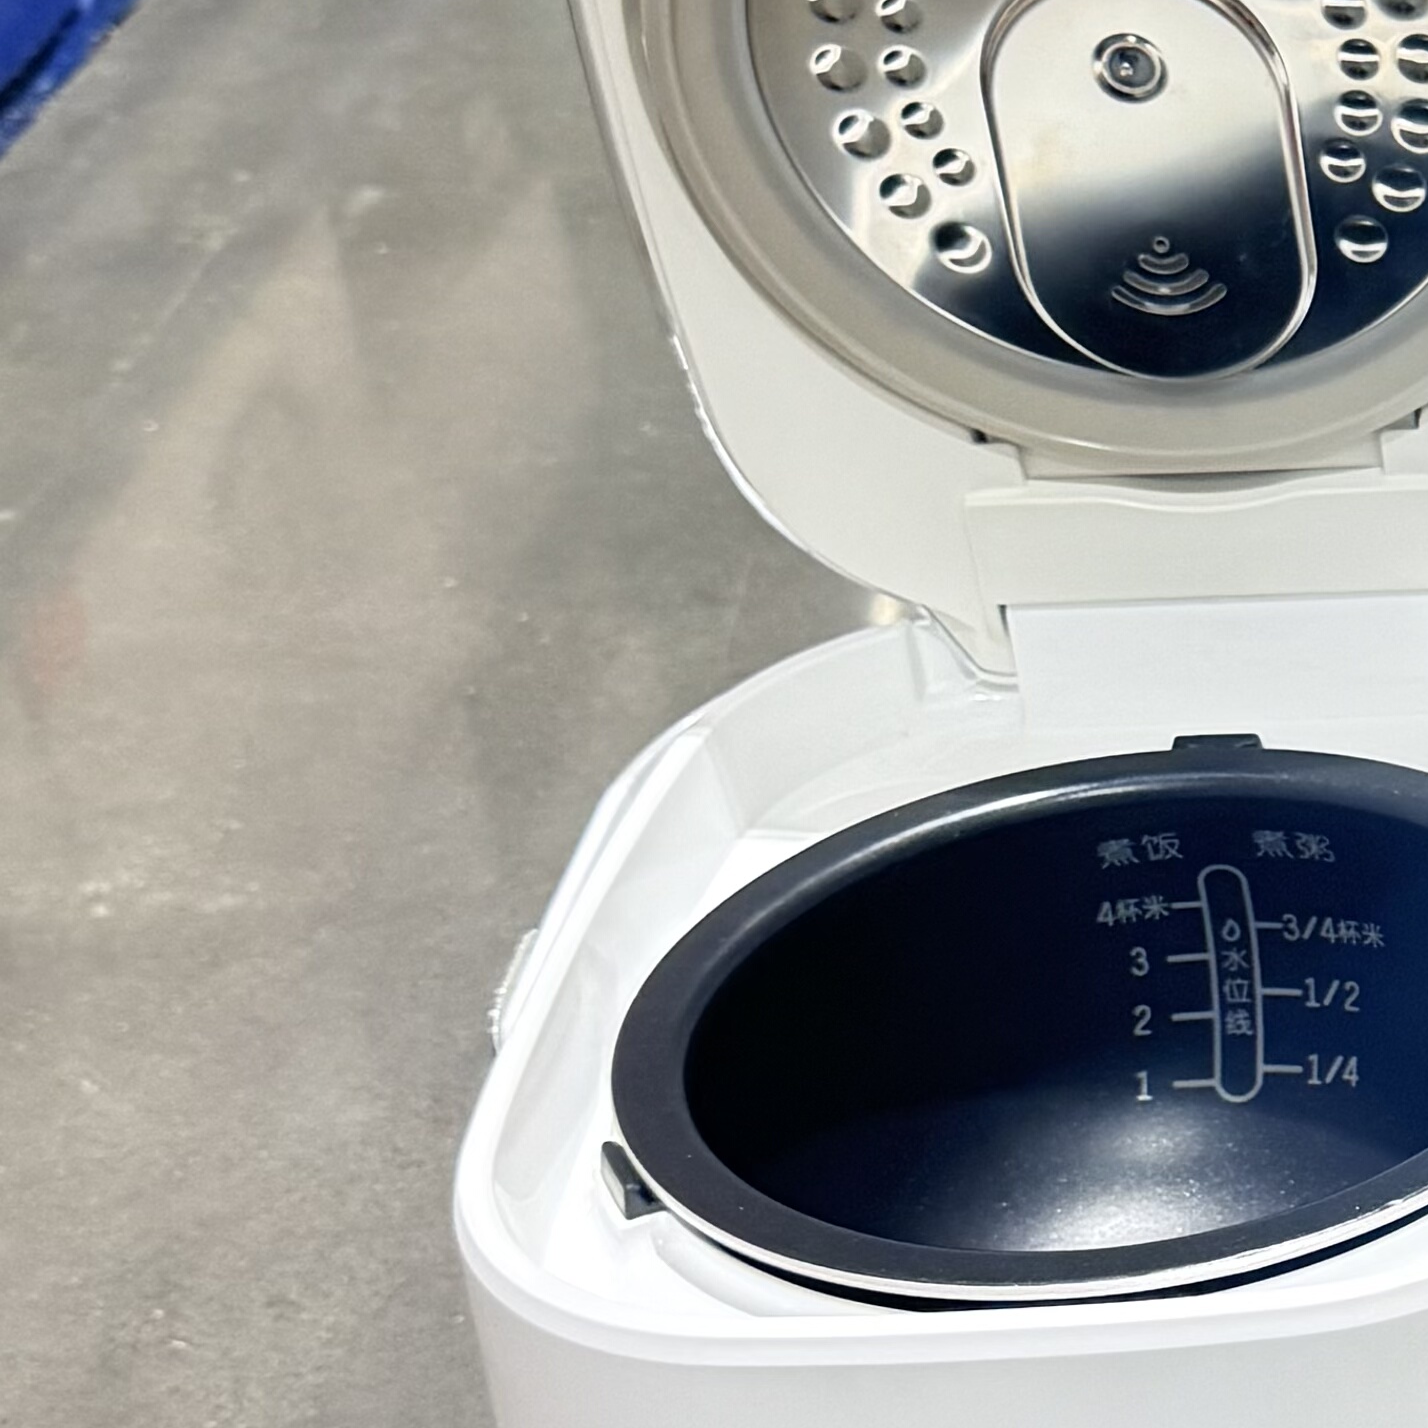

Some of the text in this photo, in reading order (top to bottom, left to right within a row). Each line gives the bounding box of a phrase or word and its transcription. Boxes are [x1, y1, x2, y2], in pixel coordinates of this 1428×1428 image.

[1098, 833, 1183, 868] 煮饭
[1252, 830, 1335, 862] 煮粥
[1097, 894, 1171, 927] 4杯米
[1282, 914, 1385, 948] 3/4杯米
[1130, 946, 1150, 977] 3
[1221, 948, 1254, 1036] 水位线
[1304, 977, 1361, 1013] 1/2
[1132, 1005, 1152, 1036] 2
[1135, 1071, 1153, 1101] 1
[1306, 1054, 1360, 1087] 1/4
